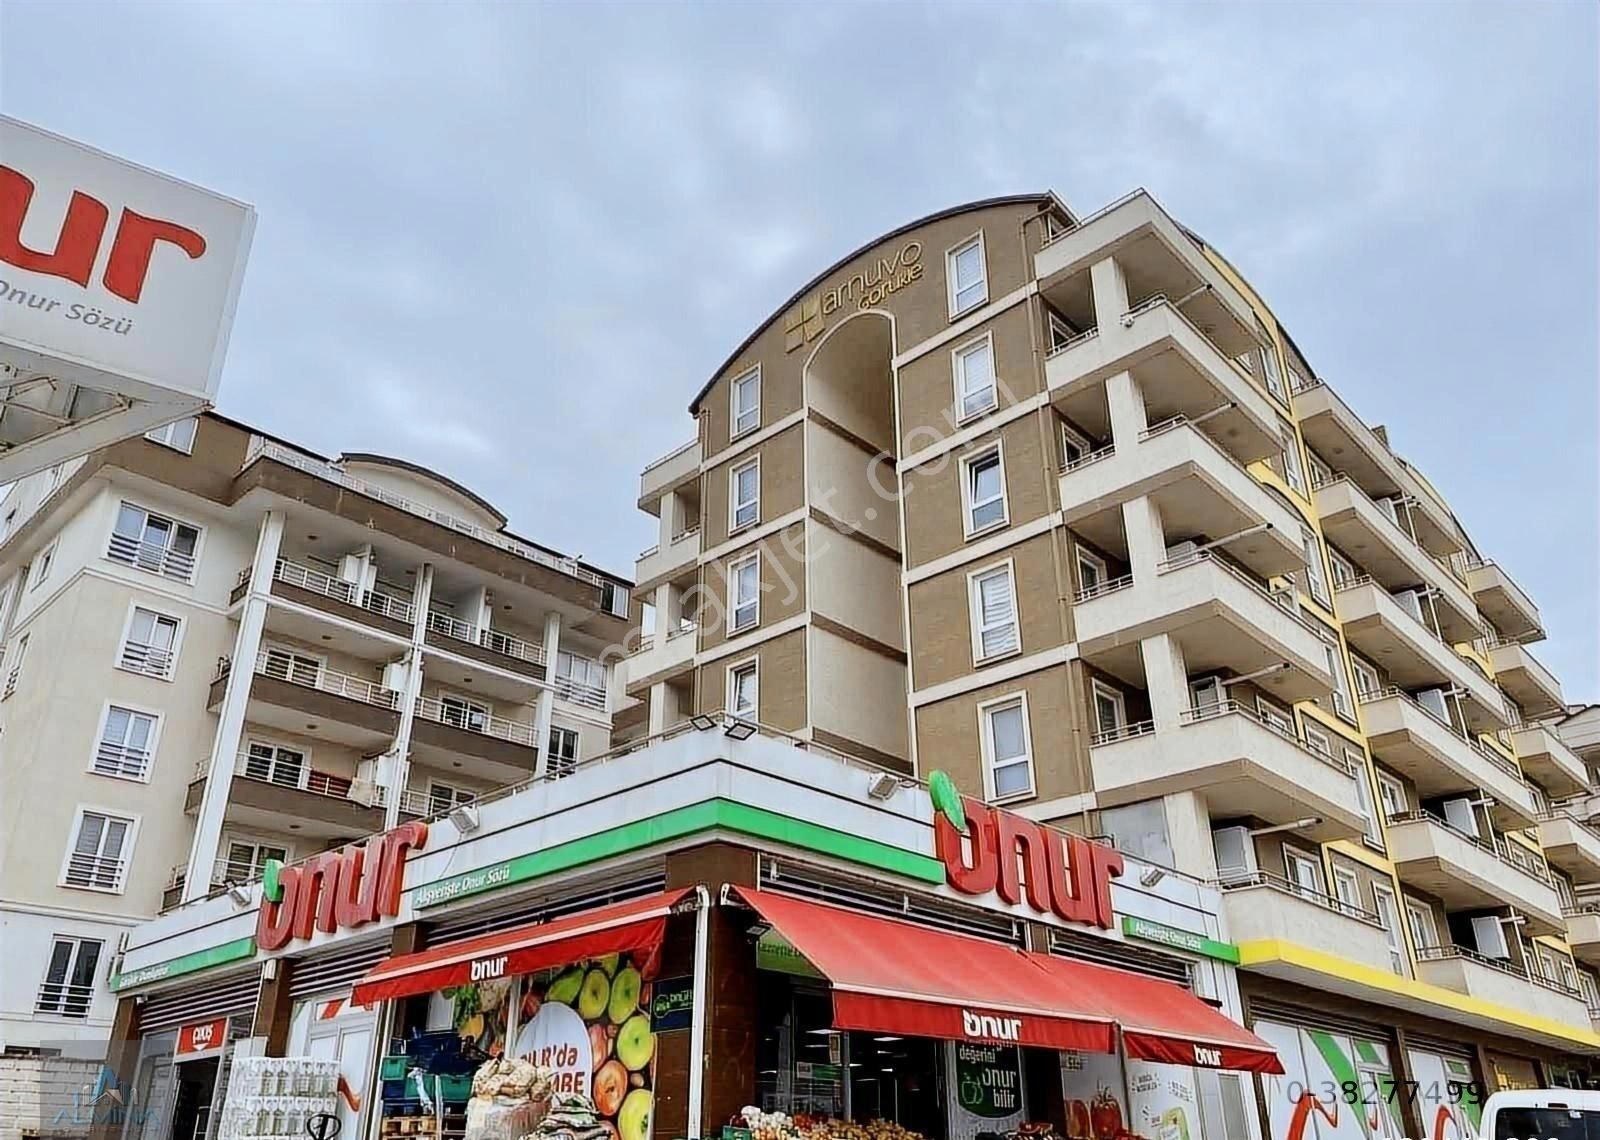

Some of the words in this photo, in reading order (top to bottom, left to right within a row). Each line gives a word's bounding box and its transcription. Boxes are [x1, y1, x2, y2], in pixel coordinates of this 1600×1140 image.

[823, 242, 922, 315] arnuvo
[65, 303, 133, 336] Sözü
[486, 864, 510, 885] Sözü
[993, 1088, 1016, 1108] bilir
